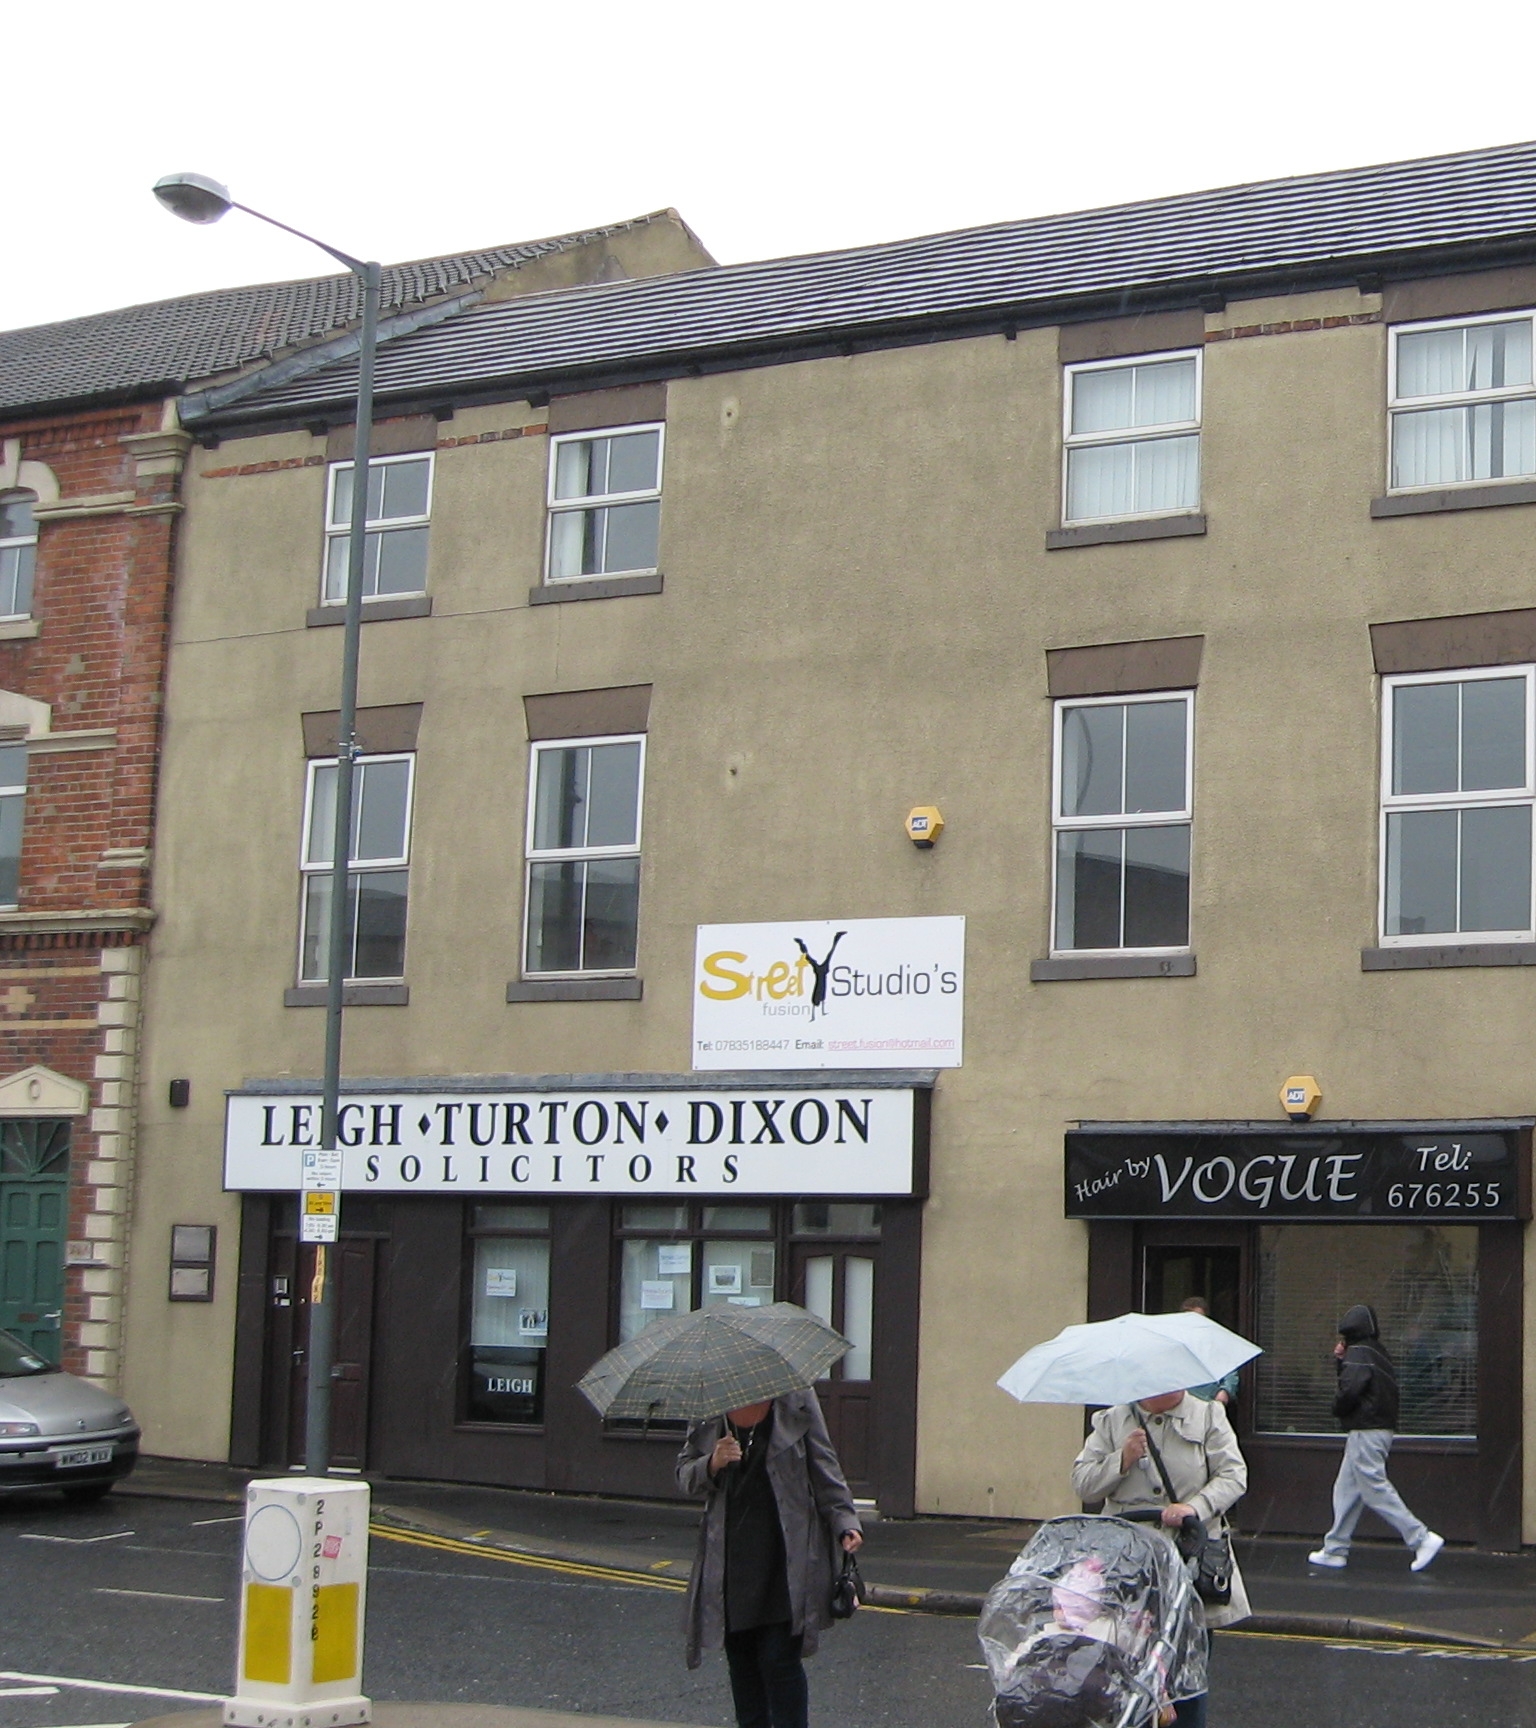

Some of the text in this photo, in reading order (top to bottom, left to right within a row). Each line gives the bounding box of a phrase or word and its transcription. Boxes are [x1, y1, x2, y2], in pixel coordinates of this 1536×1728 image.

[831, 963, 958, 996] Studio's
[763, 1003, 811, 1016] fusion
[434, 1100, 650, 1147] TURTON
[686, 1098, 873, 1146] DIXON
[365, 1154, 739, 1183] SOLICITORS
[1416, 1143, 1473, 1172] Tel:
[1074, 1153, 1363, 1208] Hair by VOGUE
[1387, 1182, 1501, 1208] 676255
[487, 1377, 534, 1393] LEIGH
